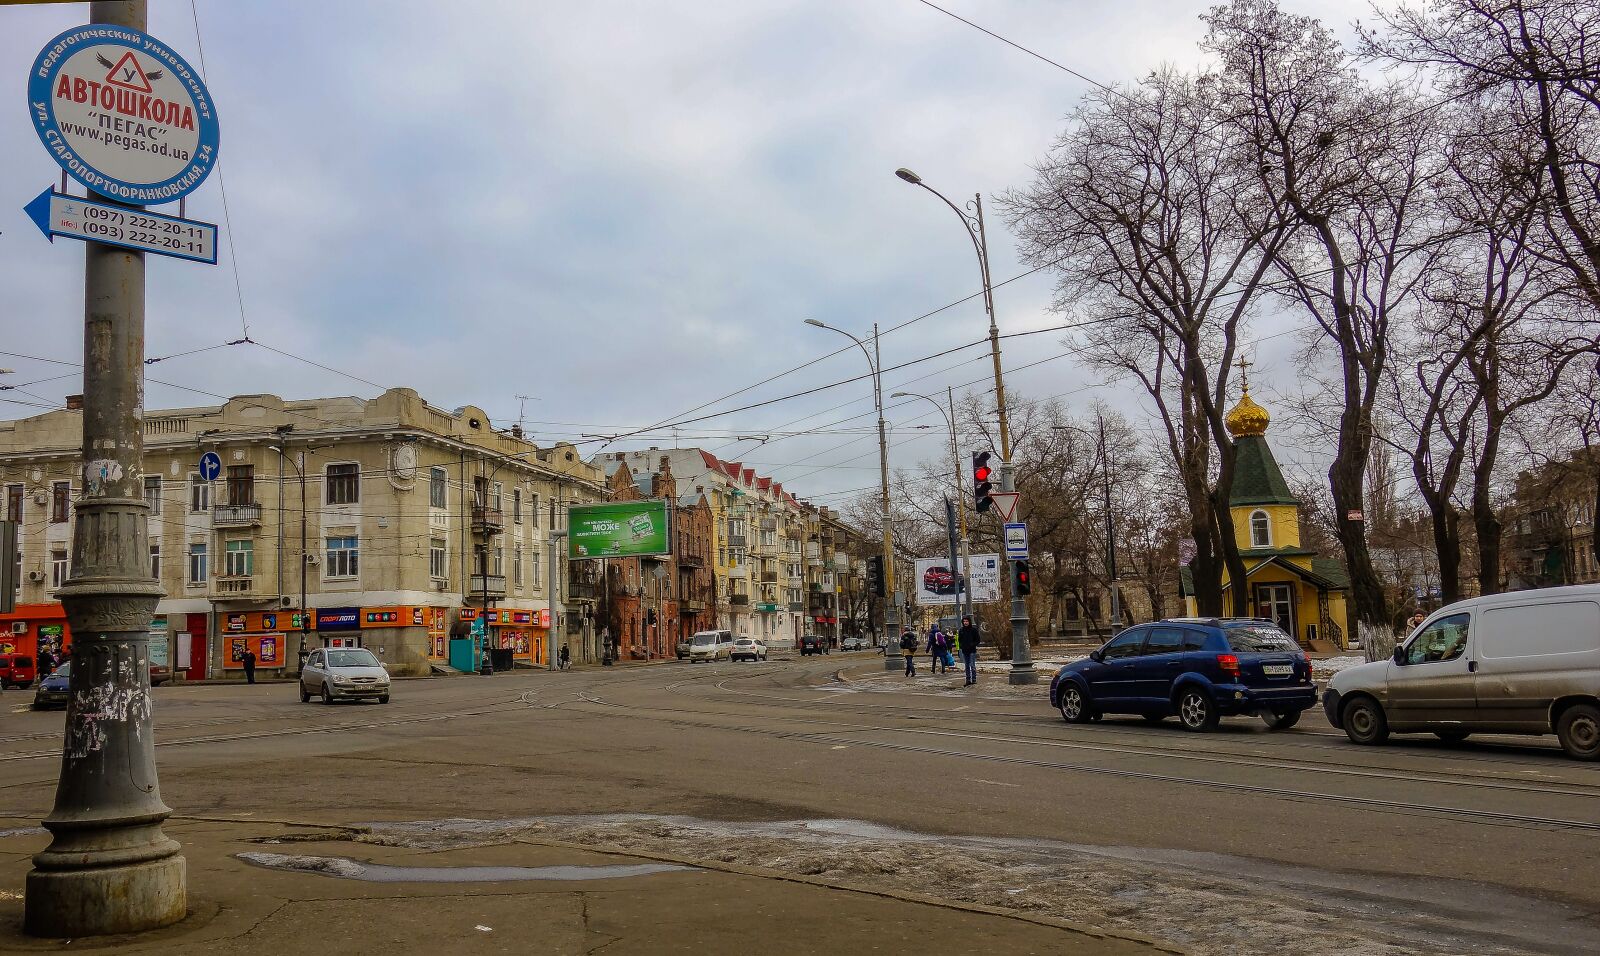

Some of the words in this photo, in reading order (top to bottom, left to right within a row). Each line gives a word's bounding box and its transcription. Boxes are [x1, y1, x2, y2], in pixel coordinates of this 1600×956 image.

[39, 28, 141, 78] педагогический
[144, 39, 210, 120] университет
[56, 73, 195, 131] АВТОШКОЛА
[60, 120, 189, 161] www.pegas.od.ua
[199, 144, 213, 163] 34
[82, 221, 124, 241] (093)
[129, 230, 203, 254] 222-20-11
[83, 205, 125, 225] (097)
[129, 216, 203, 239] 222-20-11
[592, 523, 620, 532] МОЖЕ
